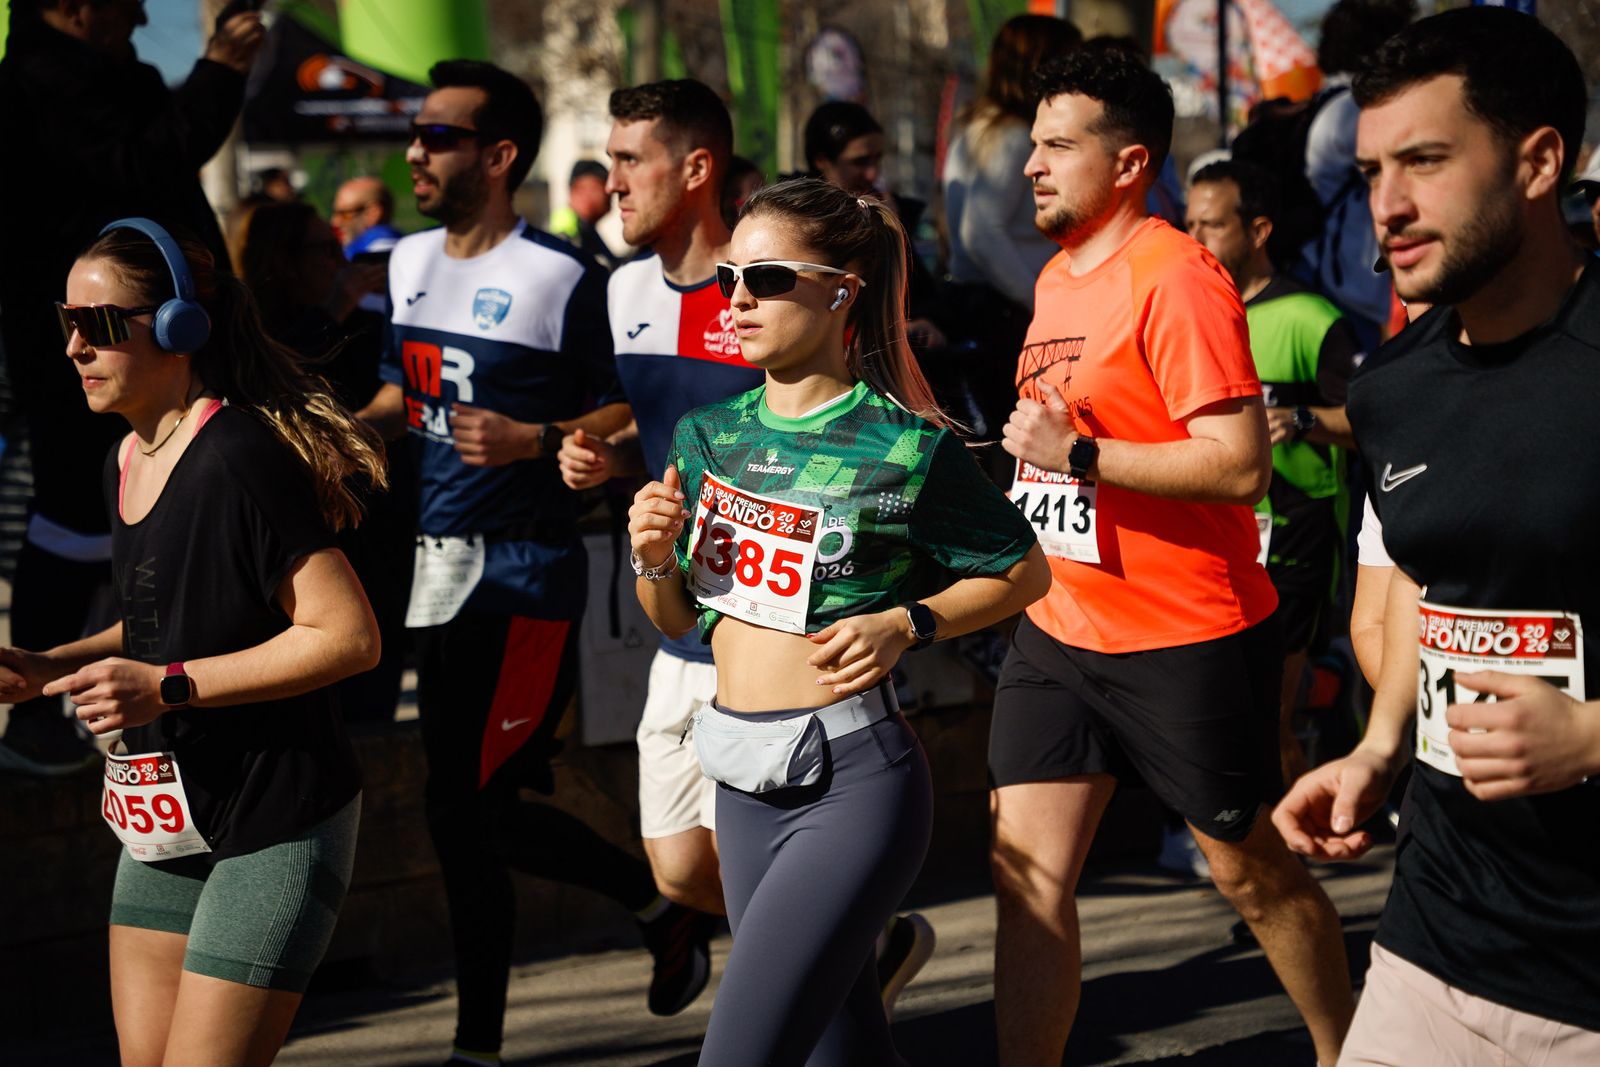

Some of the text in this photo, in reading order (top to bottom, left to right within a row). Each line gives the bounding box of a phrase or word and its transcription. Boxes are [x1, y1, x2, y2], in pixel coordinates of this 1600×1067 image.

[701, 482, 714, 503] 39
[715, 487, 735, 501] GRAN
[735, 495, 767, 513] PREMIO
[777, 511, 795, 523] 20
[1015, 492, 1091, 534] 1413
[777, 522, 795, 534] 26
[828, 516, 846, 528] DE
[692, 515, 804, 598] 2385
[811, 560, 855, 581] 026
[1428, 615, 1454, 629] GRAN
[1455, 618, 1504, 633] PREMIO
[1521, 624, 1546, 639] 20
[1426, 625, 1521, 656] FONDO
[1524, 638, 1550, 653] 26
[140, 763, 153, 773] 20
[145, 771, 159, 782] 26
